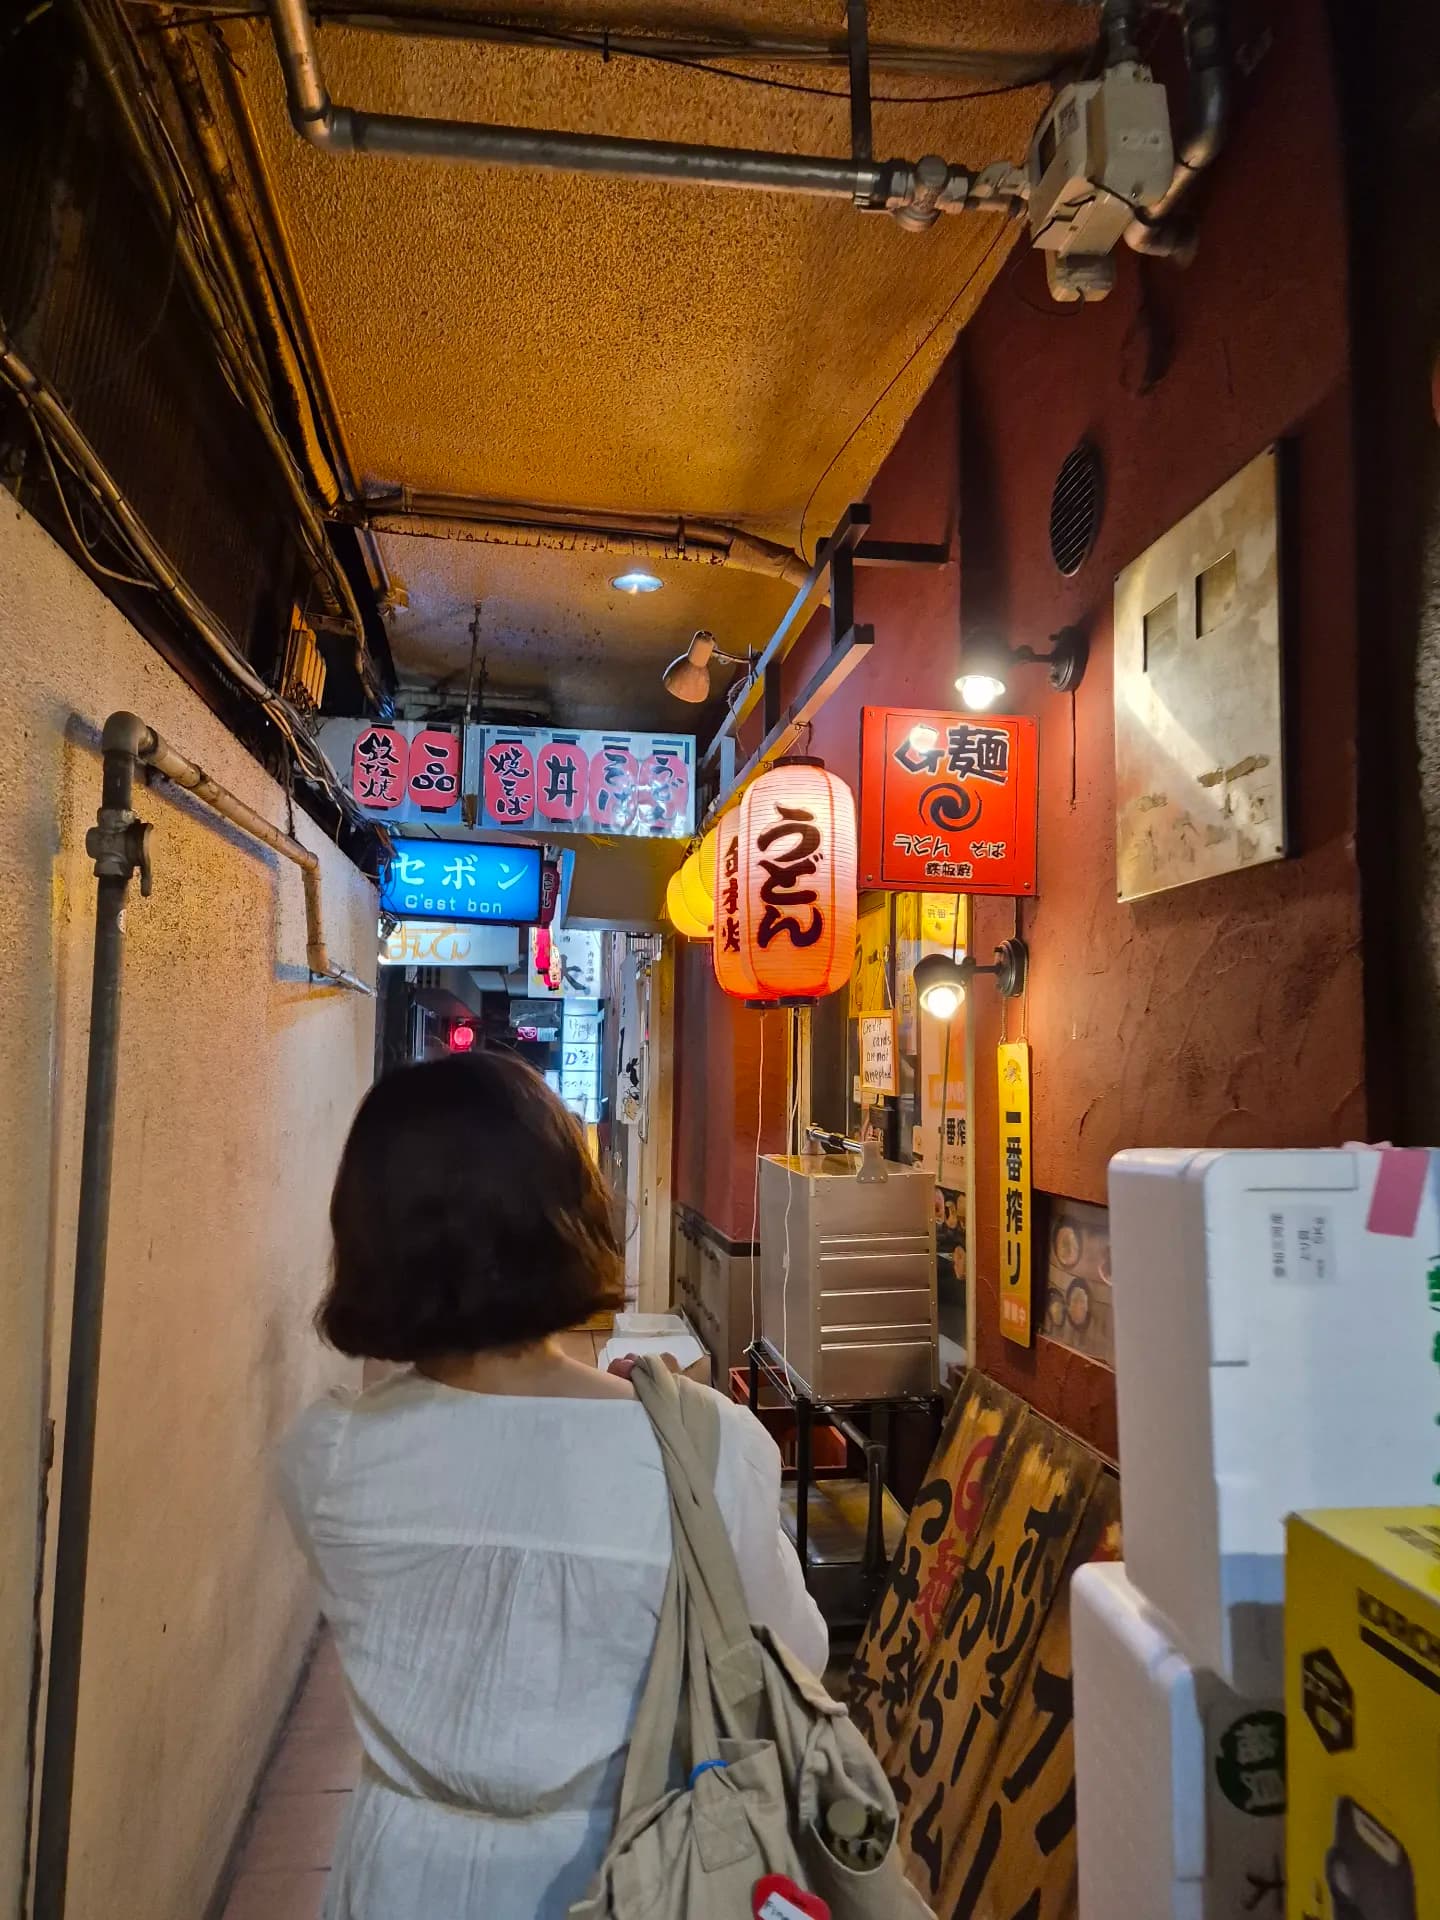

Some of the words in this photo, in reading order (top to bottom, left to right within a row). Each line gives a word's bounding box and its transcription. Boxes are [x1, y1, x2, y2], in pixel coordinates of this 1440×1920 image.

[412, 743, 456, 792] 一品
[489, 746, 531, 816] 焼そば
[543, 754, 578, 808] 丼
[391, 852, 528, 890] セボン
[756, 801, 824, 949] うどん
[405, 893, 456, 911] C'est
[467, 897, 502, 914] bon
[1005, 1111, 1023, 1286] 一番搾り
